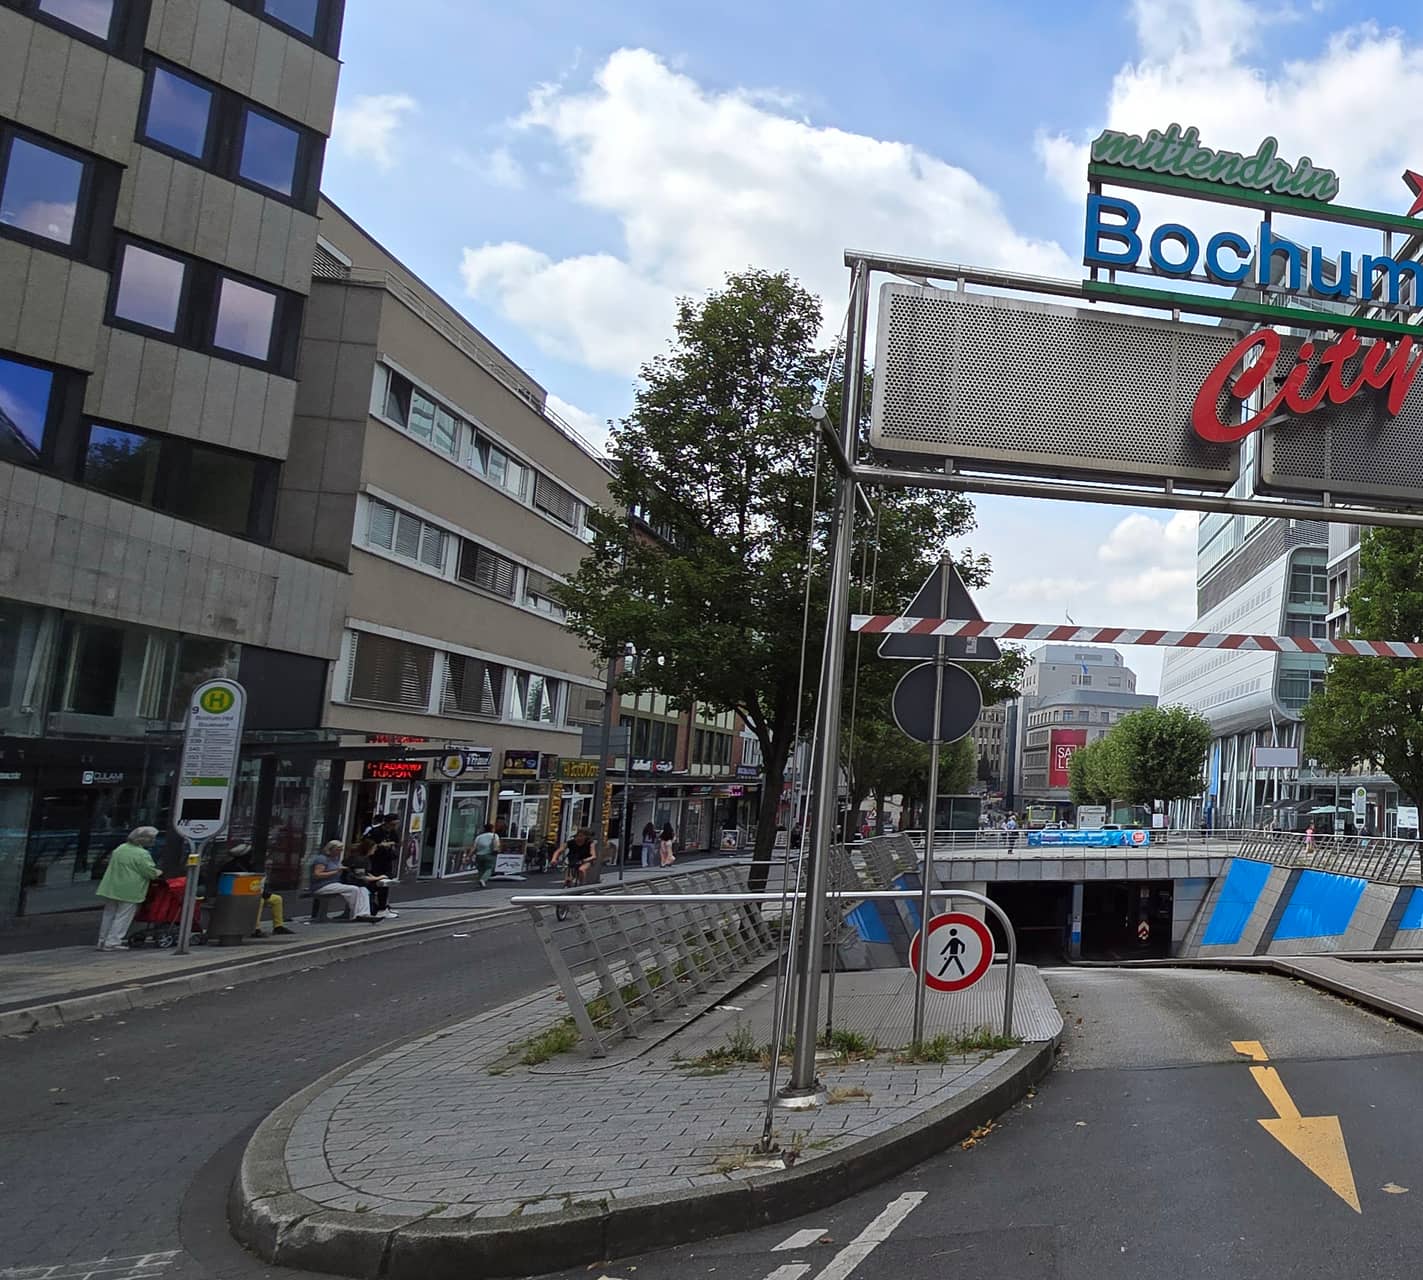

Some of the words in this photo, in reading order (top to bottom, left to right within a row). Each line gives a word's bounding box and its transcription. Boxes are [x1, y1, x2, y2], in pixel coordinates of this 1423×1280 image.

[1091, 123, 1339, 201] mittendrin
[1192, 328, 1423, 442] City
[191, 705, 200, 715] 9
